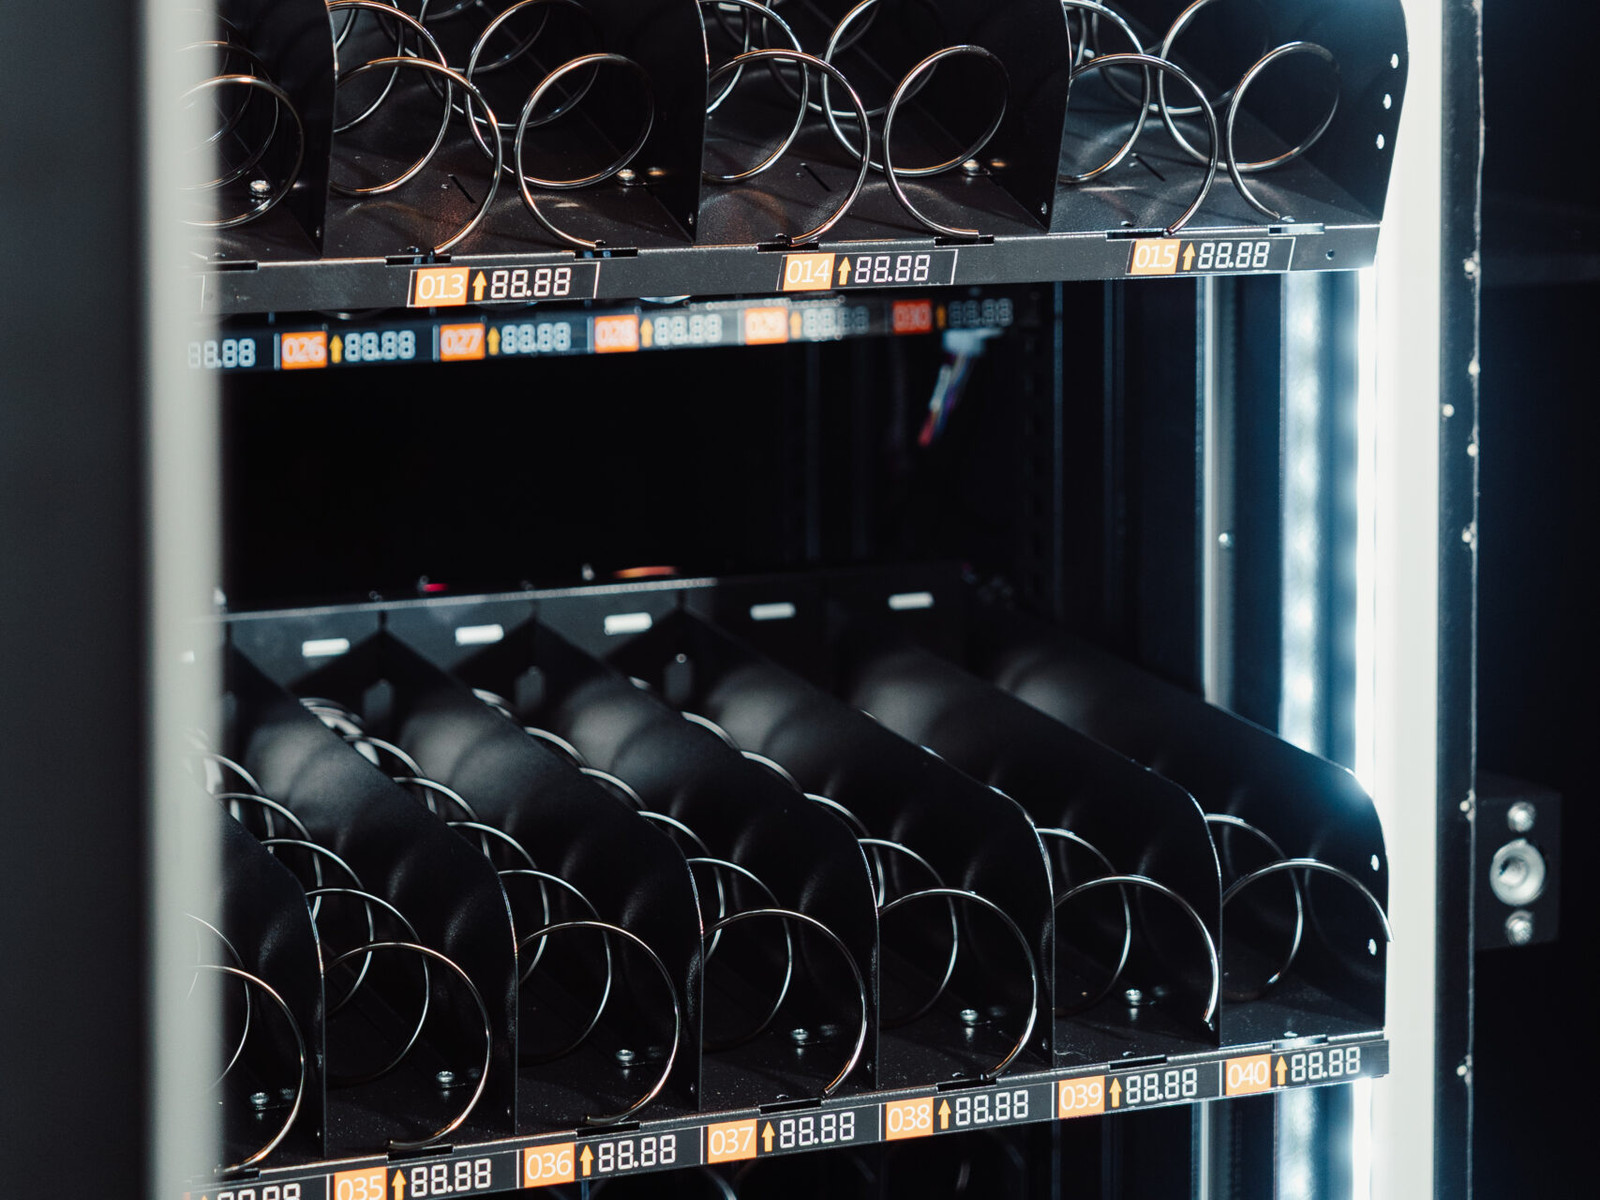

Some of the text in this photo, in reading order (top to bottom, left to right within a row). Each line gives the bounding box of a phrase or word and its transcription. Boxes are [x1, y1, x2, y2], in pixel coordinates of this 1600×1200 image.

[787, 255, 930, 284] 014 88.88
[1134, 242, 1270, 269] 015 88.88
[418, 268, 571, 299] 013 88.88
[282, 330, 415, 363] 026 88.88
[441, 322, 571, 356] 027 88.88
[1227, 1046, 1361, 1087] 040 88.88
[1060, 1068, 1197, 1111] 039 88.88
[888, 1090, 1029, 1133] 038 88.88
[710, 1112, 855, 1156] 037 88.88
[526, 1134, 676, 1180] 036 88.88
[337, 1175, 384, 1200] 035
[410, 1158, 492, 1197] 88.88
